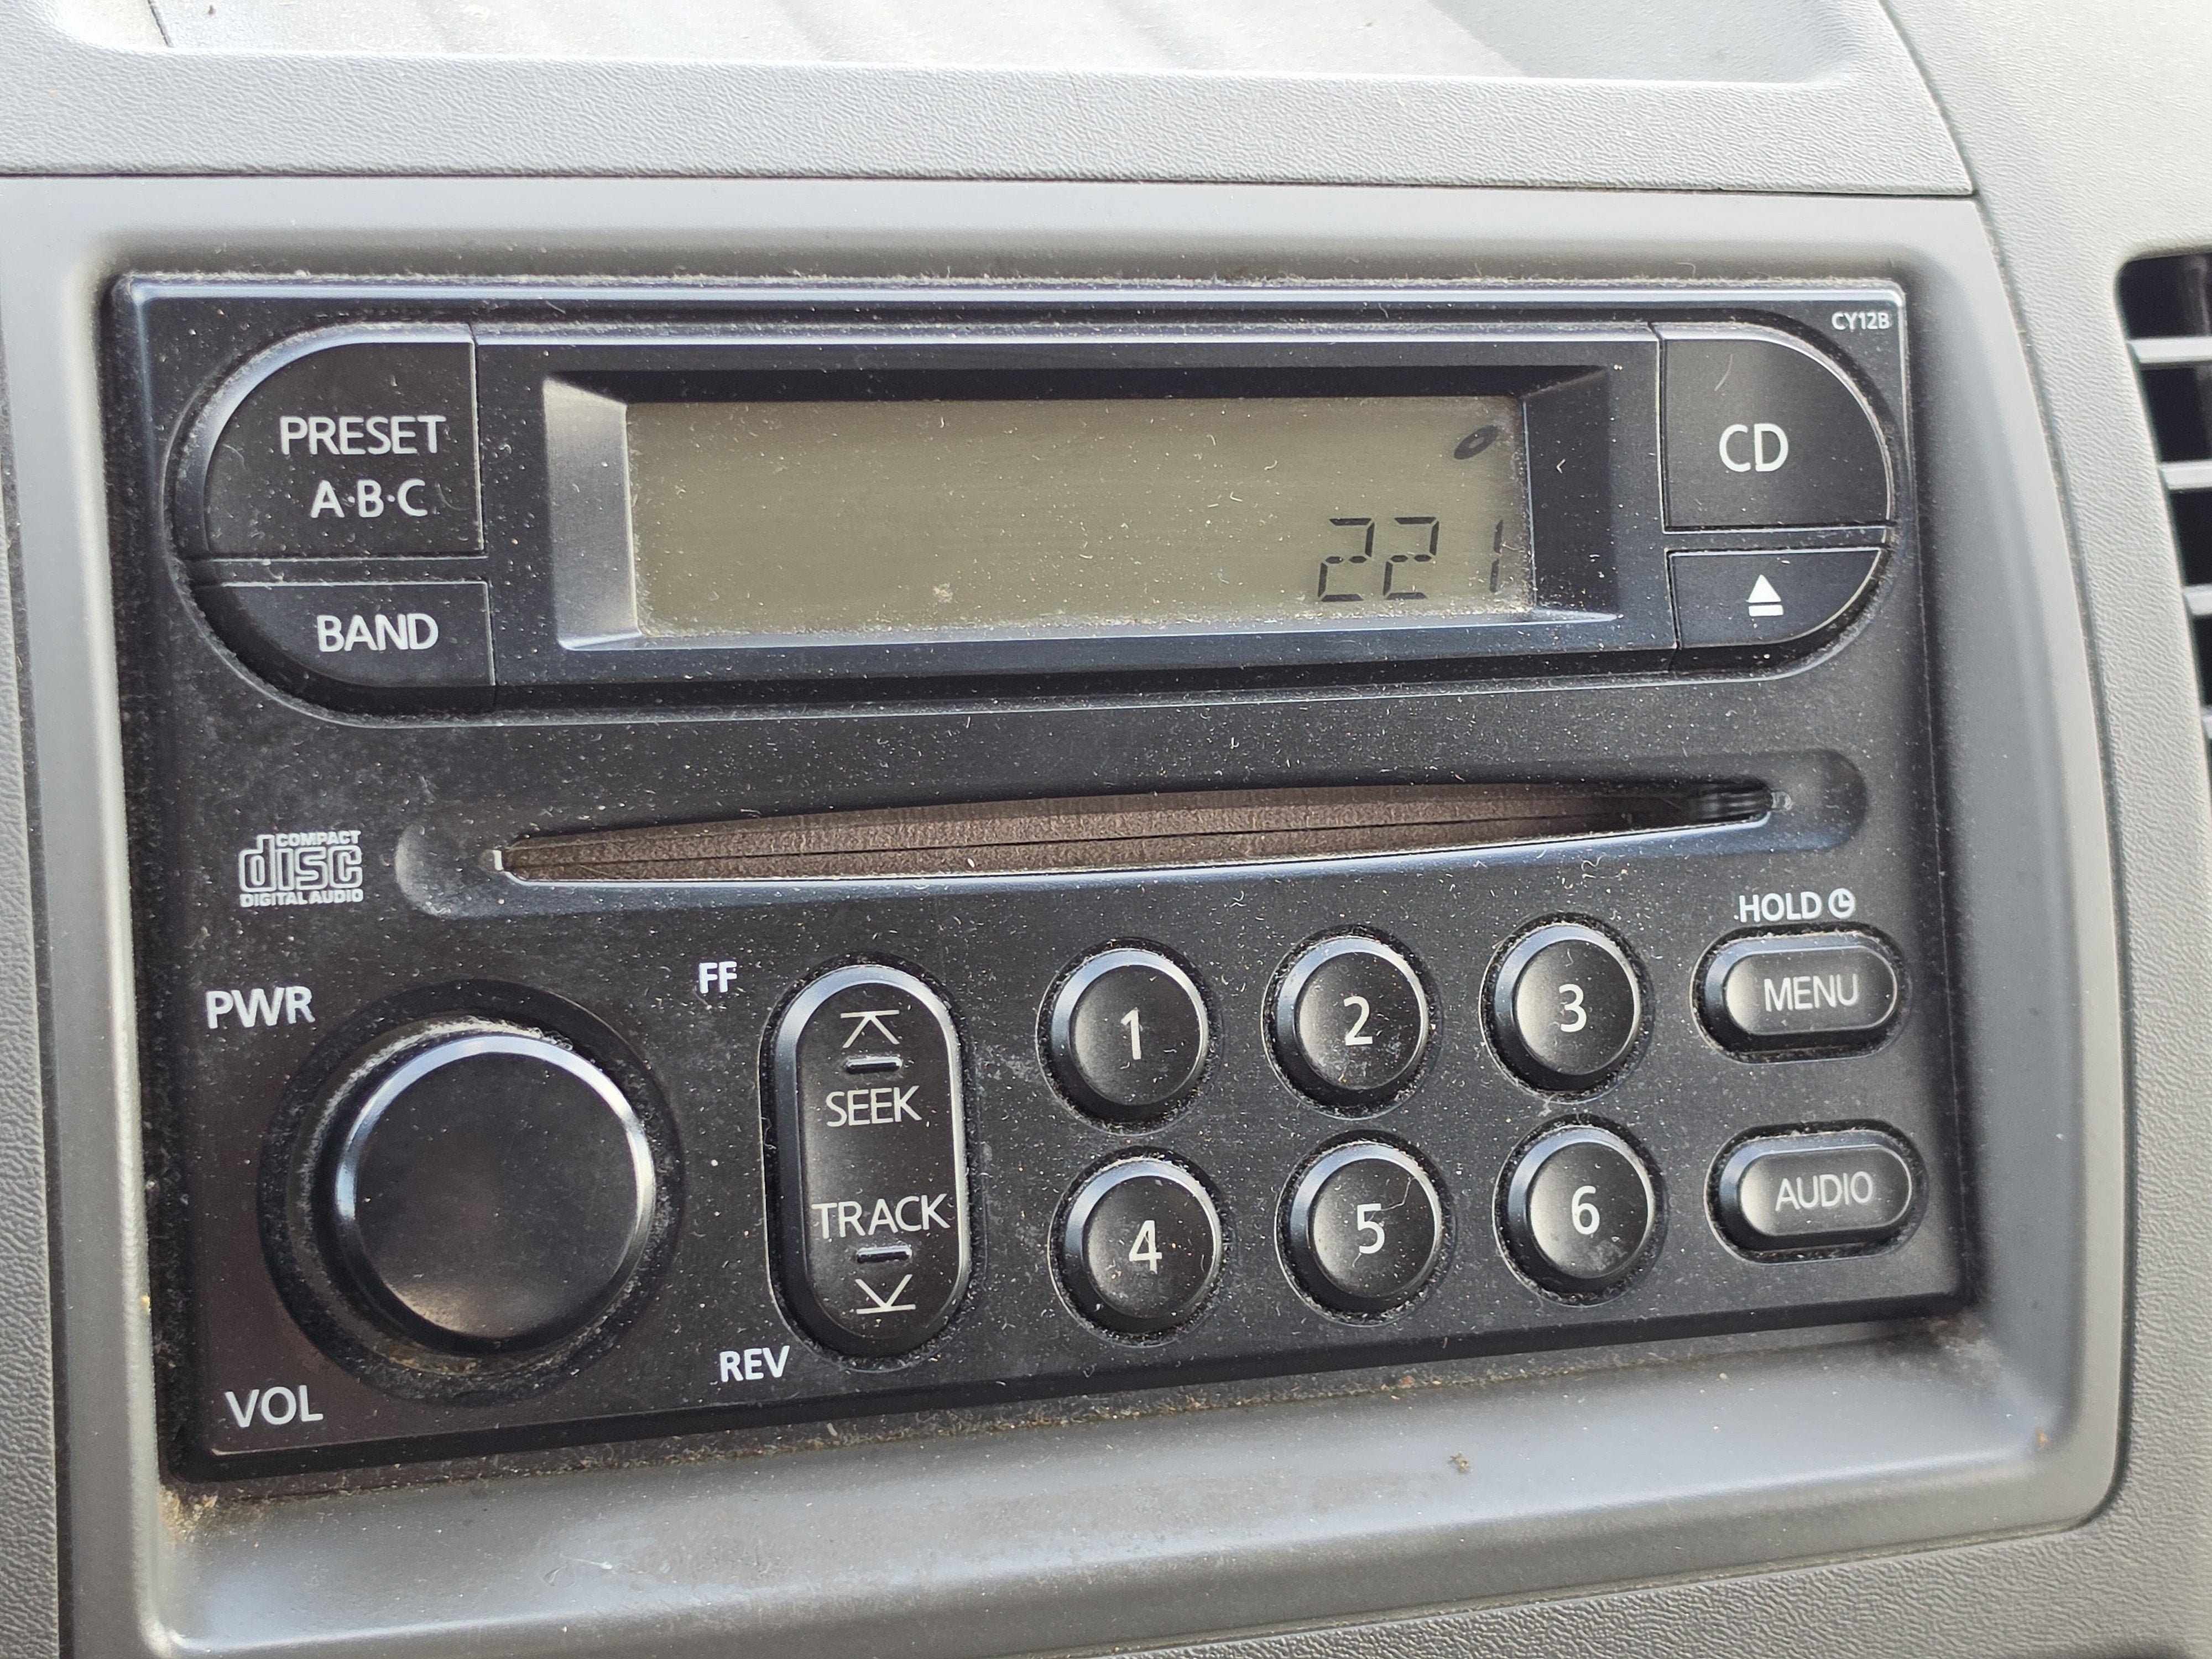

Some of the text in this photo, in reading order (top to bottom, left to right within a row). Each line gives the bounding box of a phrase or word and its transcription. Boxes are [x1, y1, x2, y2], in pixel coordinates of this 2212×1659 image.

[1832, 311, 1892, 331] CY12B
[279, 415, 447, 455] PRESET
[1719, 423, 1788, 472] CD
[316, 613, 439, 652] BAND
[276, 830, 361, 847] COMPACT
[239, 888, 364, 907] DIGITAL AUDIO
[1739, 891, 1823, 923] HOLD
[698, 961, 737, 994] FF
[1764, 973, 1859, 1012] MENU
[205, 985, 315, 1029] PWR
[1343, 993, 1373, 1046] 2
[1557, 983, 1587, 1032] 3
[1120, 1007, 1141, 1060] 1
[825, 1086, 921, 1127] SEEK
[1571, 1185, 1600, 1235] 6
[1775, 1171, 1874, 1212] AUDIO
[810, 1194, 950, 1240] TRACK
[1357, 1203, 1385, 1254] 5
[1128, 1220, 1162, 1274] 4
[719, 1345, 790, 1383] REV
[225, 1385, 323, 1428] VOL
